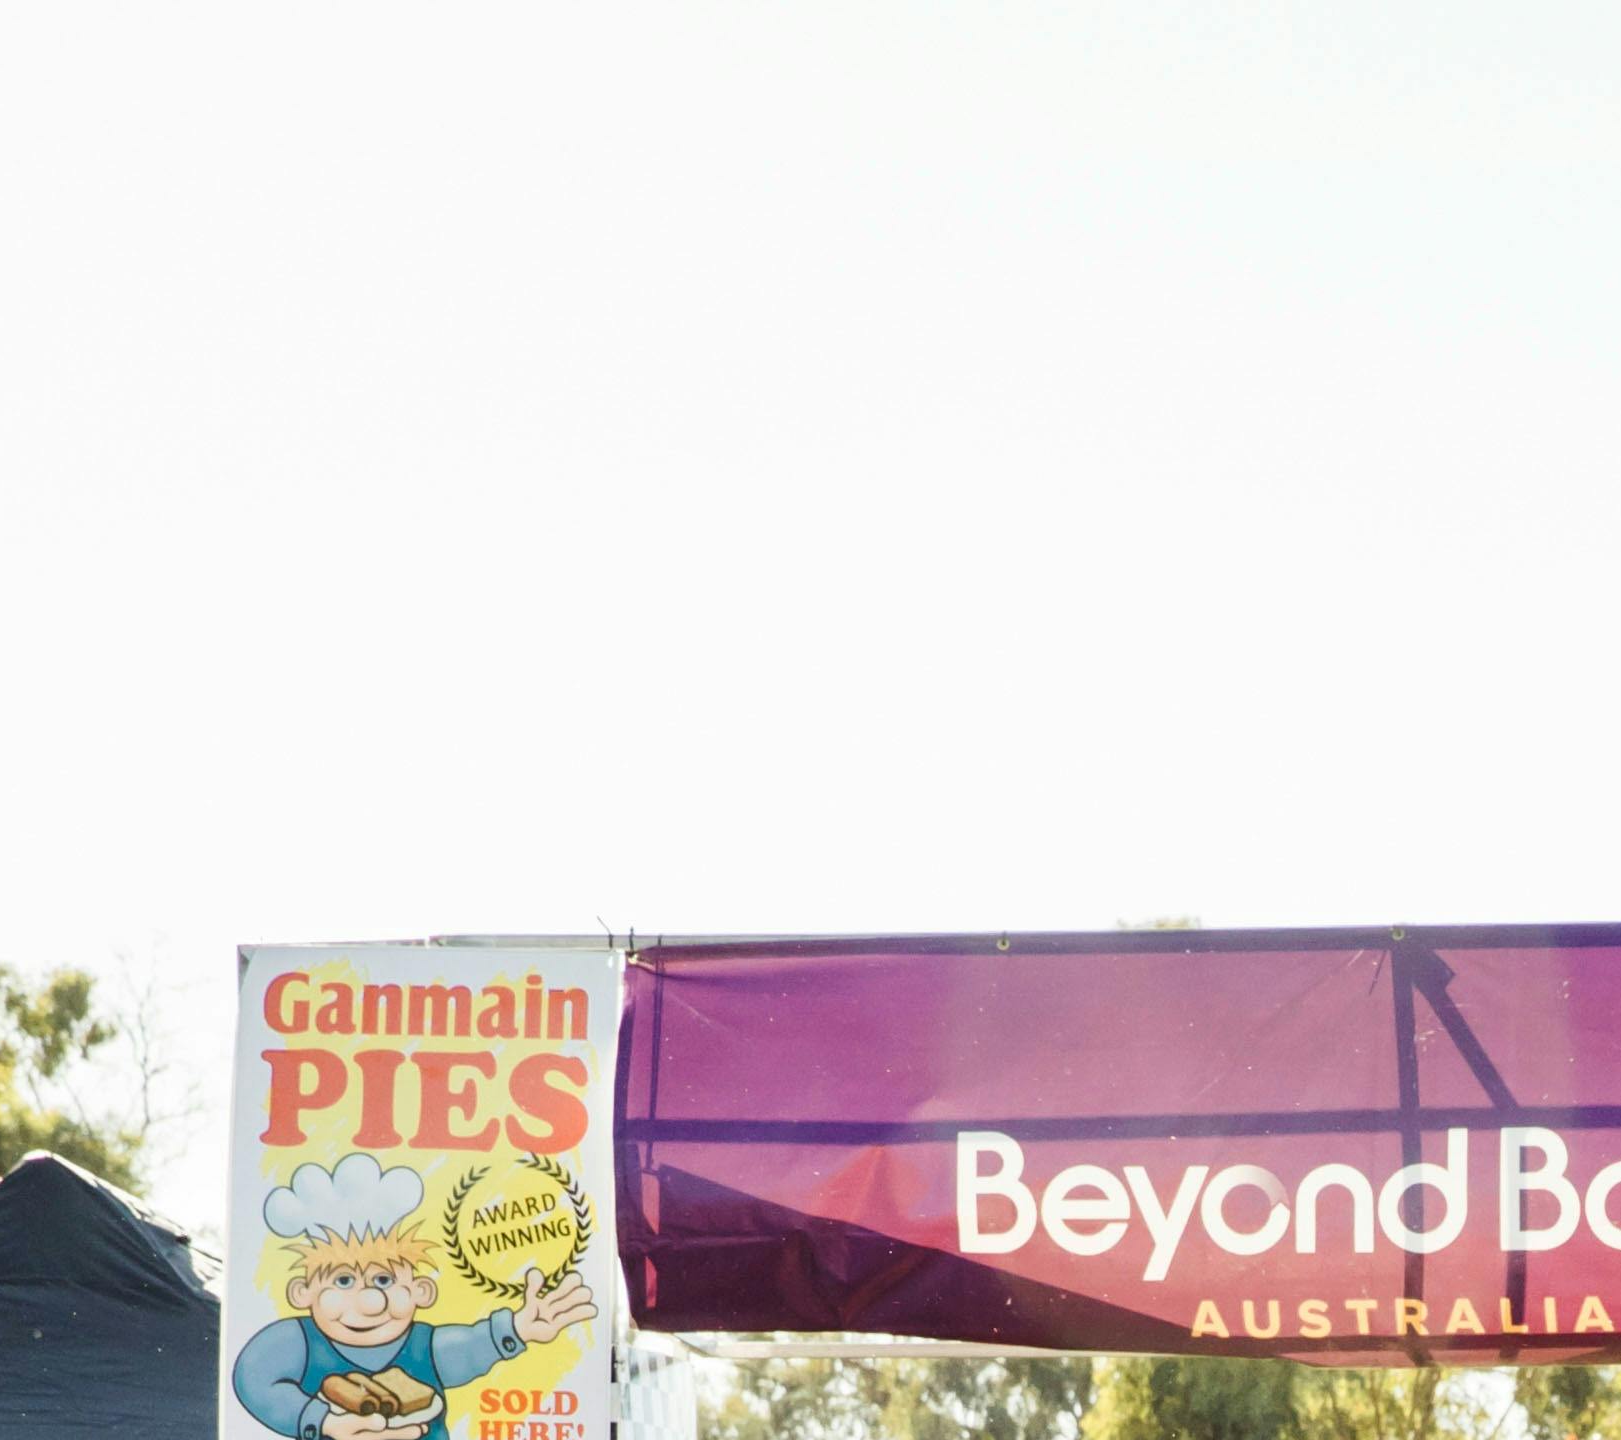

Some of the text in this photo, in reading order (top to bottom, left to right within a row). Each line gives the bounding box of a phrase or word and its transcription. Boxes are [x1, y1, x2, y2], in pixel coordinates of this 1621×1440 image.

[263, 971, 590, 1041] Ganmain
[259, 1048, 590, 1154] PIES
[472, 1192, 557, 1229] AWARD
[956, 1127, 1468, 1282] Beyond
[467, 1217, 572, 1259] WINNING
[1191, 1295, 1615, 1339] AUSTRALIA
[480, 1389, 579, 1416] SOLD
